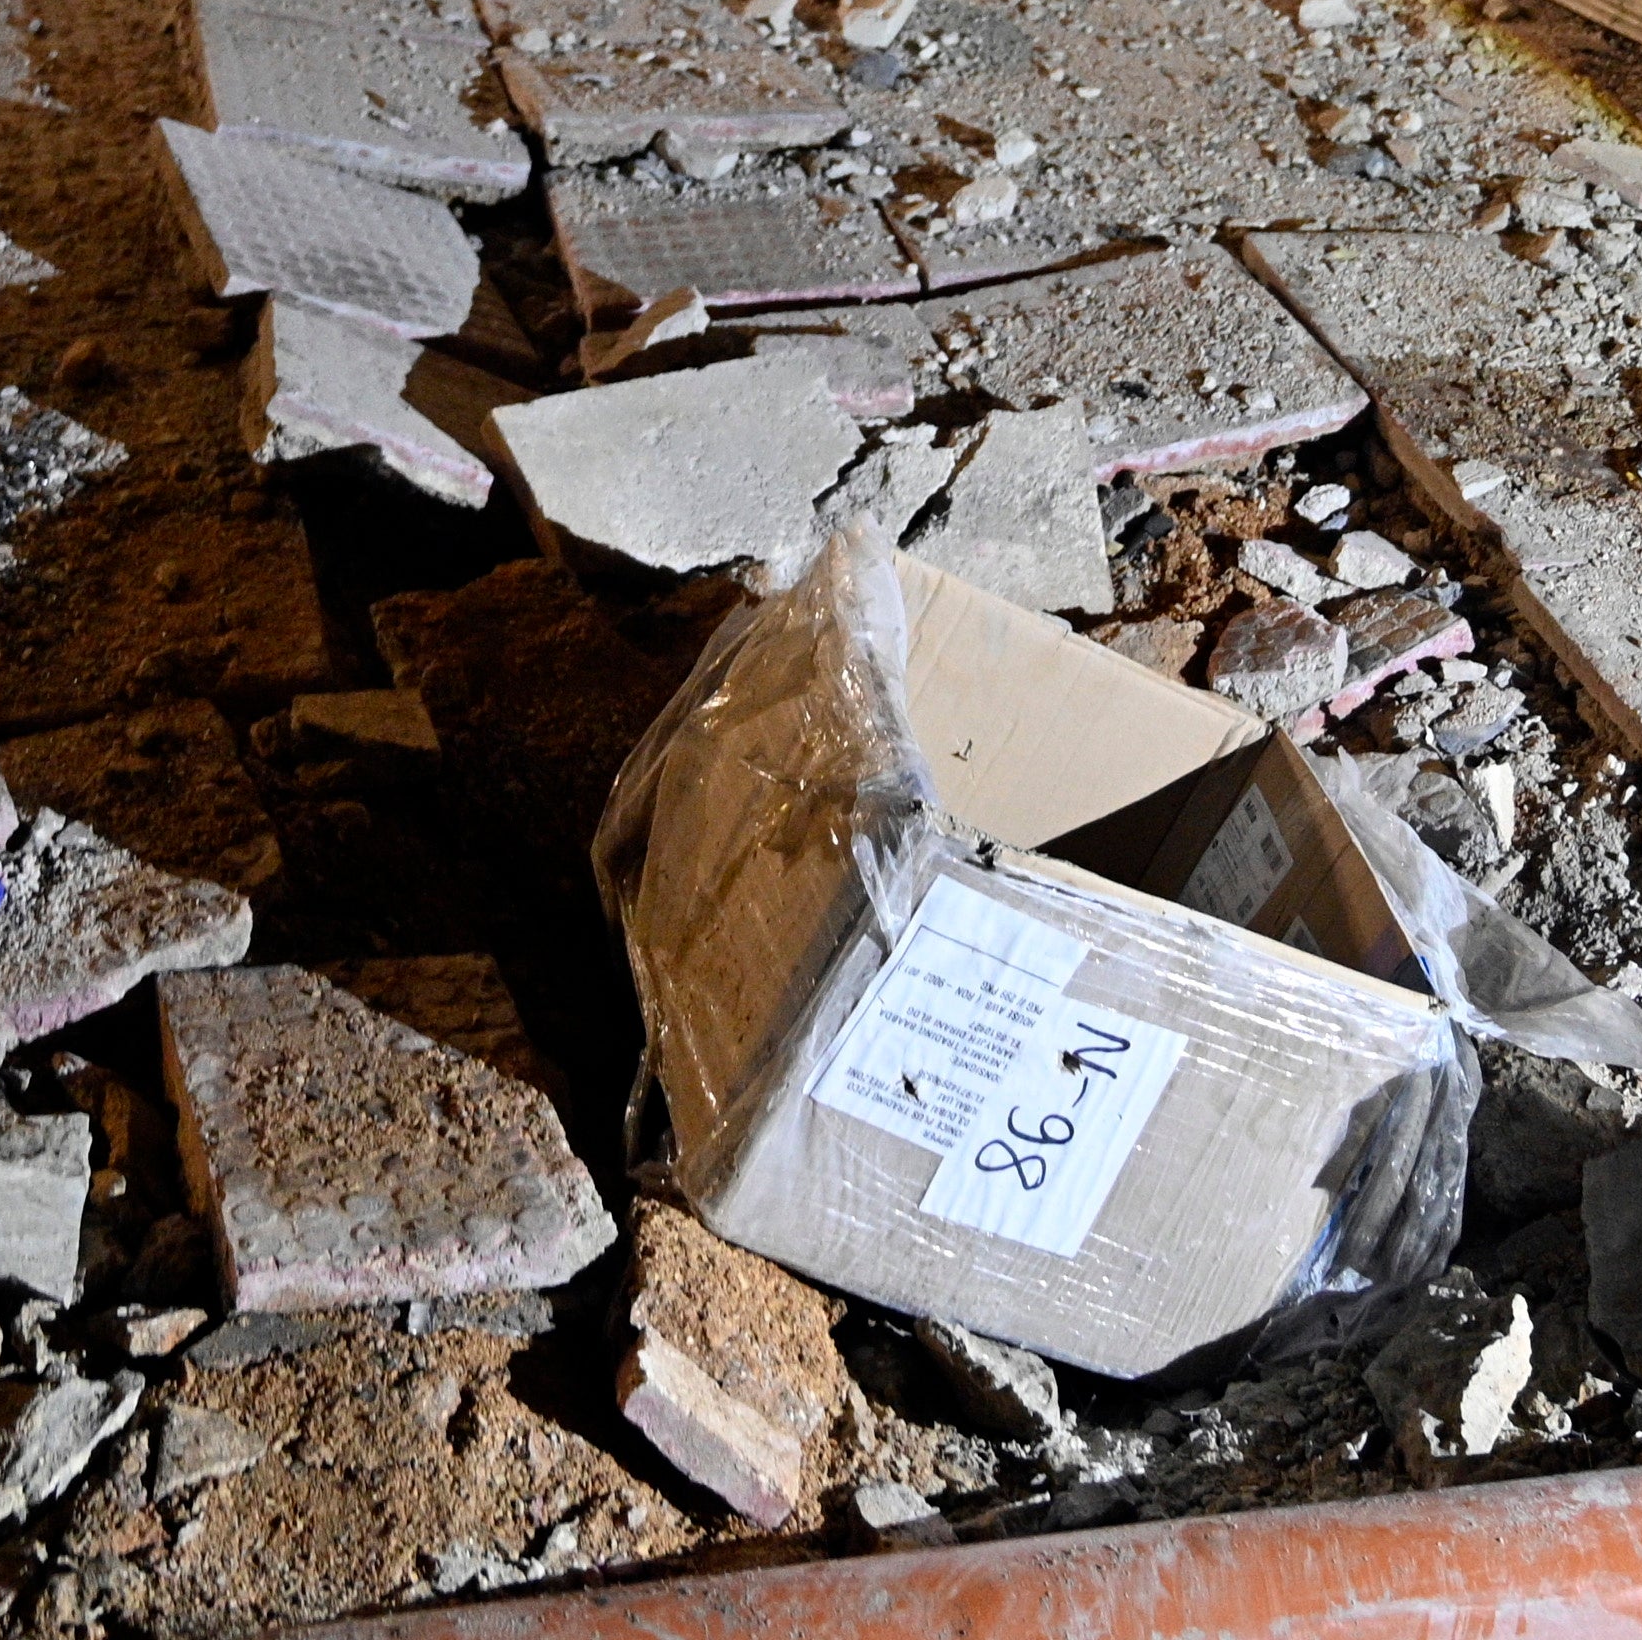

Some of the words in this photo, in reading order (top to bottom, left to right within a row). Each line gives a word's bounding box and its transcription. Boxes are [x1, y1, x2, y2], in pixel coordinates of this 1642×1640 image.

[876, 1007, 917, 1031] BAABDA
[1006, 1009, 1036, 1028] HOUSE
[916, 1025, 960, 1050] TRADING
[870, 1092, 910, 1115] TRADING
[974, 1021, 1131, 1191] N-98
